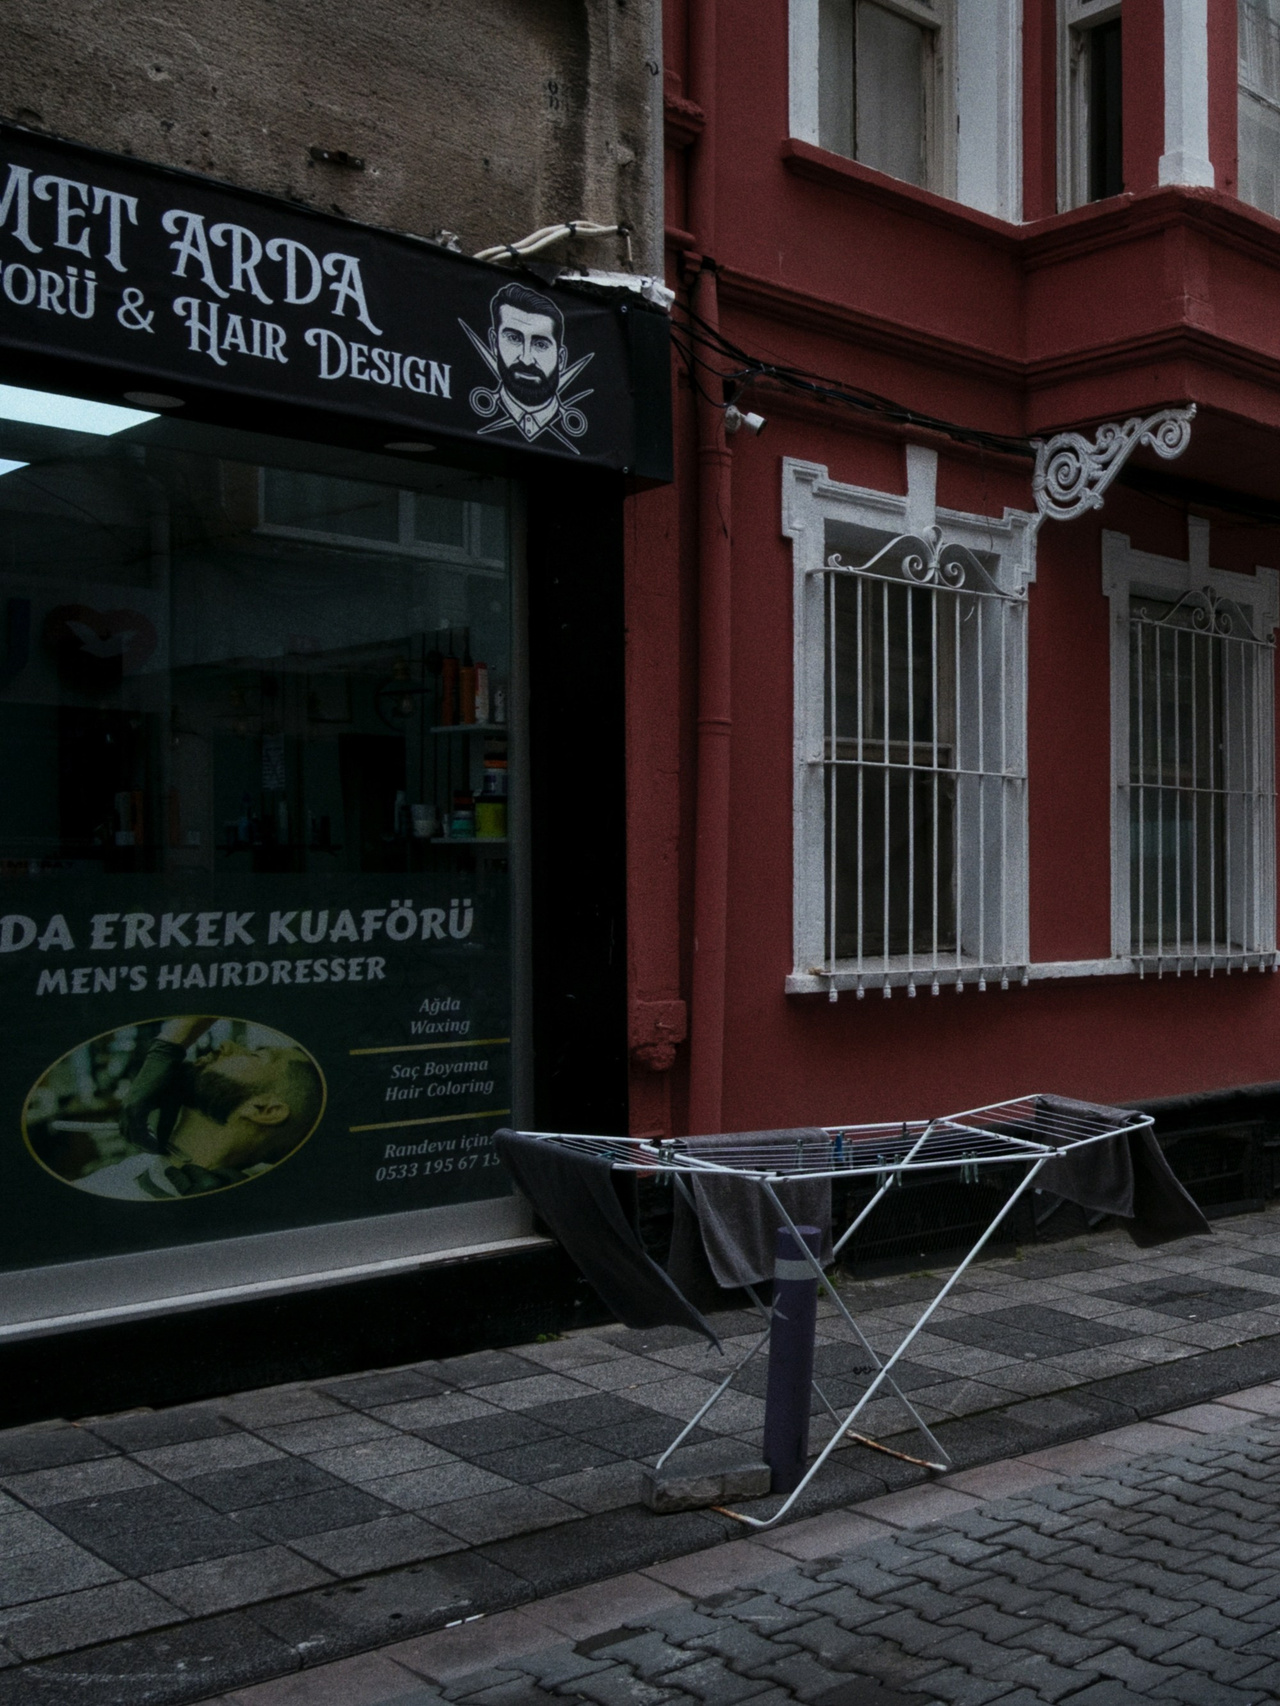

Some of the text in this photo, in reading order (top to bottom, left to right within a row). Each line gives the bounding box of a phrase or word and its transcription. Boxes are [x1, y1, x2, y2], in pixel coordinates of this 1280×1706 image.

[162, 209, 382, 337] ARDA
[0, 259, 98, 320] ORÜ
[117, 287, 155, 334] &
[0, 898, 474, 954] DA ERKEK KUAFÖRÜ
[36, 956, 386, 996] MEN'S HAIRDRESSER
[419, 996, 461, 1016] Ağda
[410, 1019, 470, 1035] Waxing
[390, 1059, 489, 1081] Saç Boyama
[385, 1079, 494, 1102] Hair Coloring
[384, 1139, 456, 1160] Randevu
[375, 1163, 418, 1182] 0533
[423, 1158, 453, 1176] 195
[458, 1154, 479, 1171] 67
